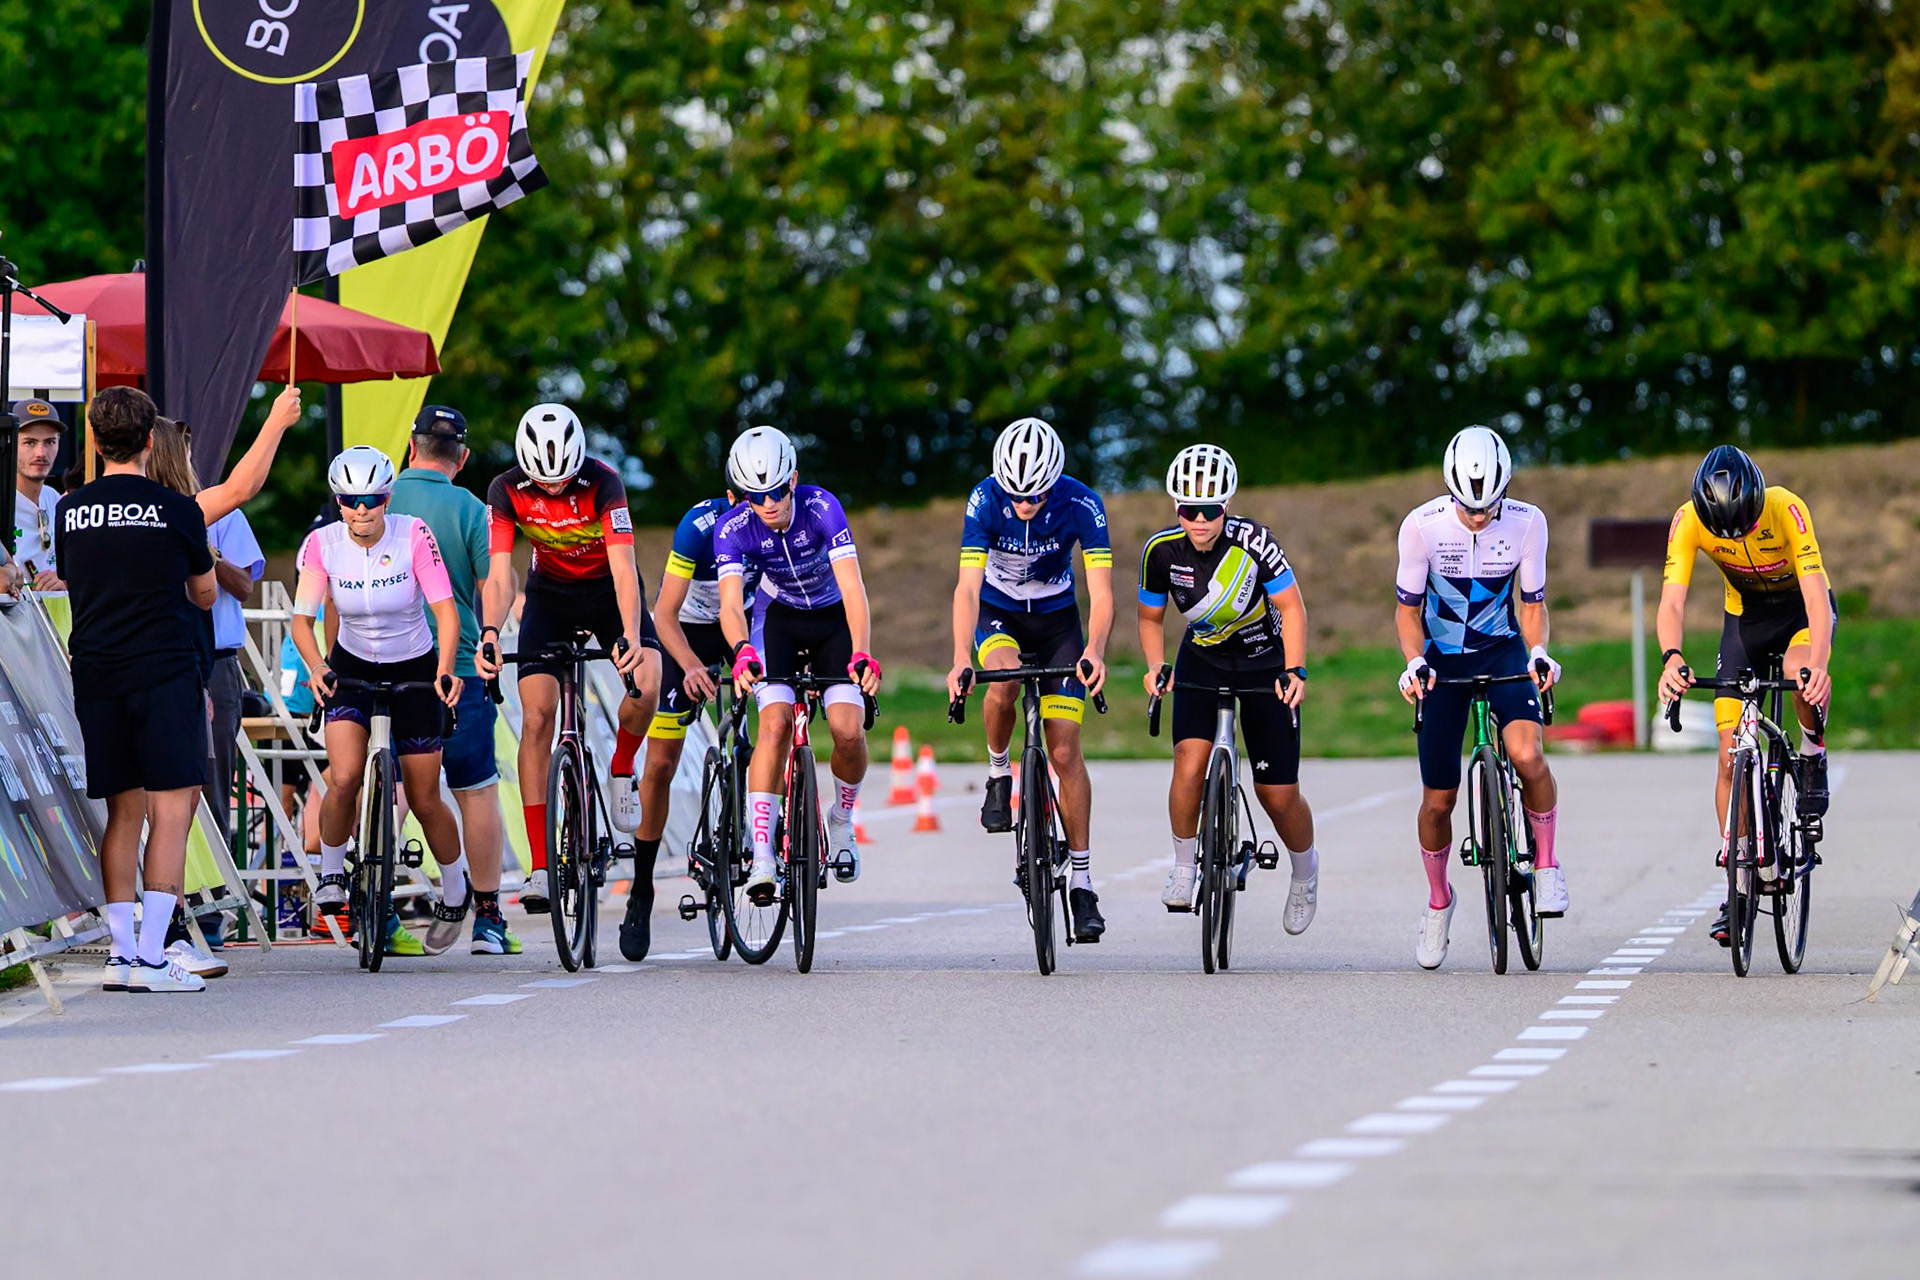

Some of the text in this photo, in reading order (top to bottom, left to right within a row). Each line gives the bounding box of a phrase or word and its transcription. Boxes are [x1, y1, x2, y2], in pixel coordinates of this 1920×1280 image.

[418, 3, 470, 64] OA
[347, 112, 500, 208] ARBÖ
[65, 503, 160, 532] RCO BOA
[419, 525, 442, 567] RYSEL
[338, 572, 409, 590] VAN RYSEL
